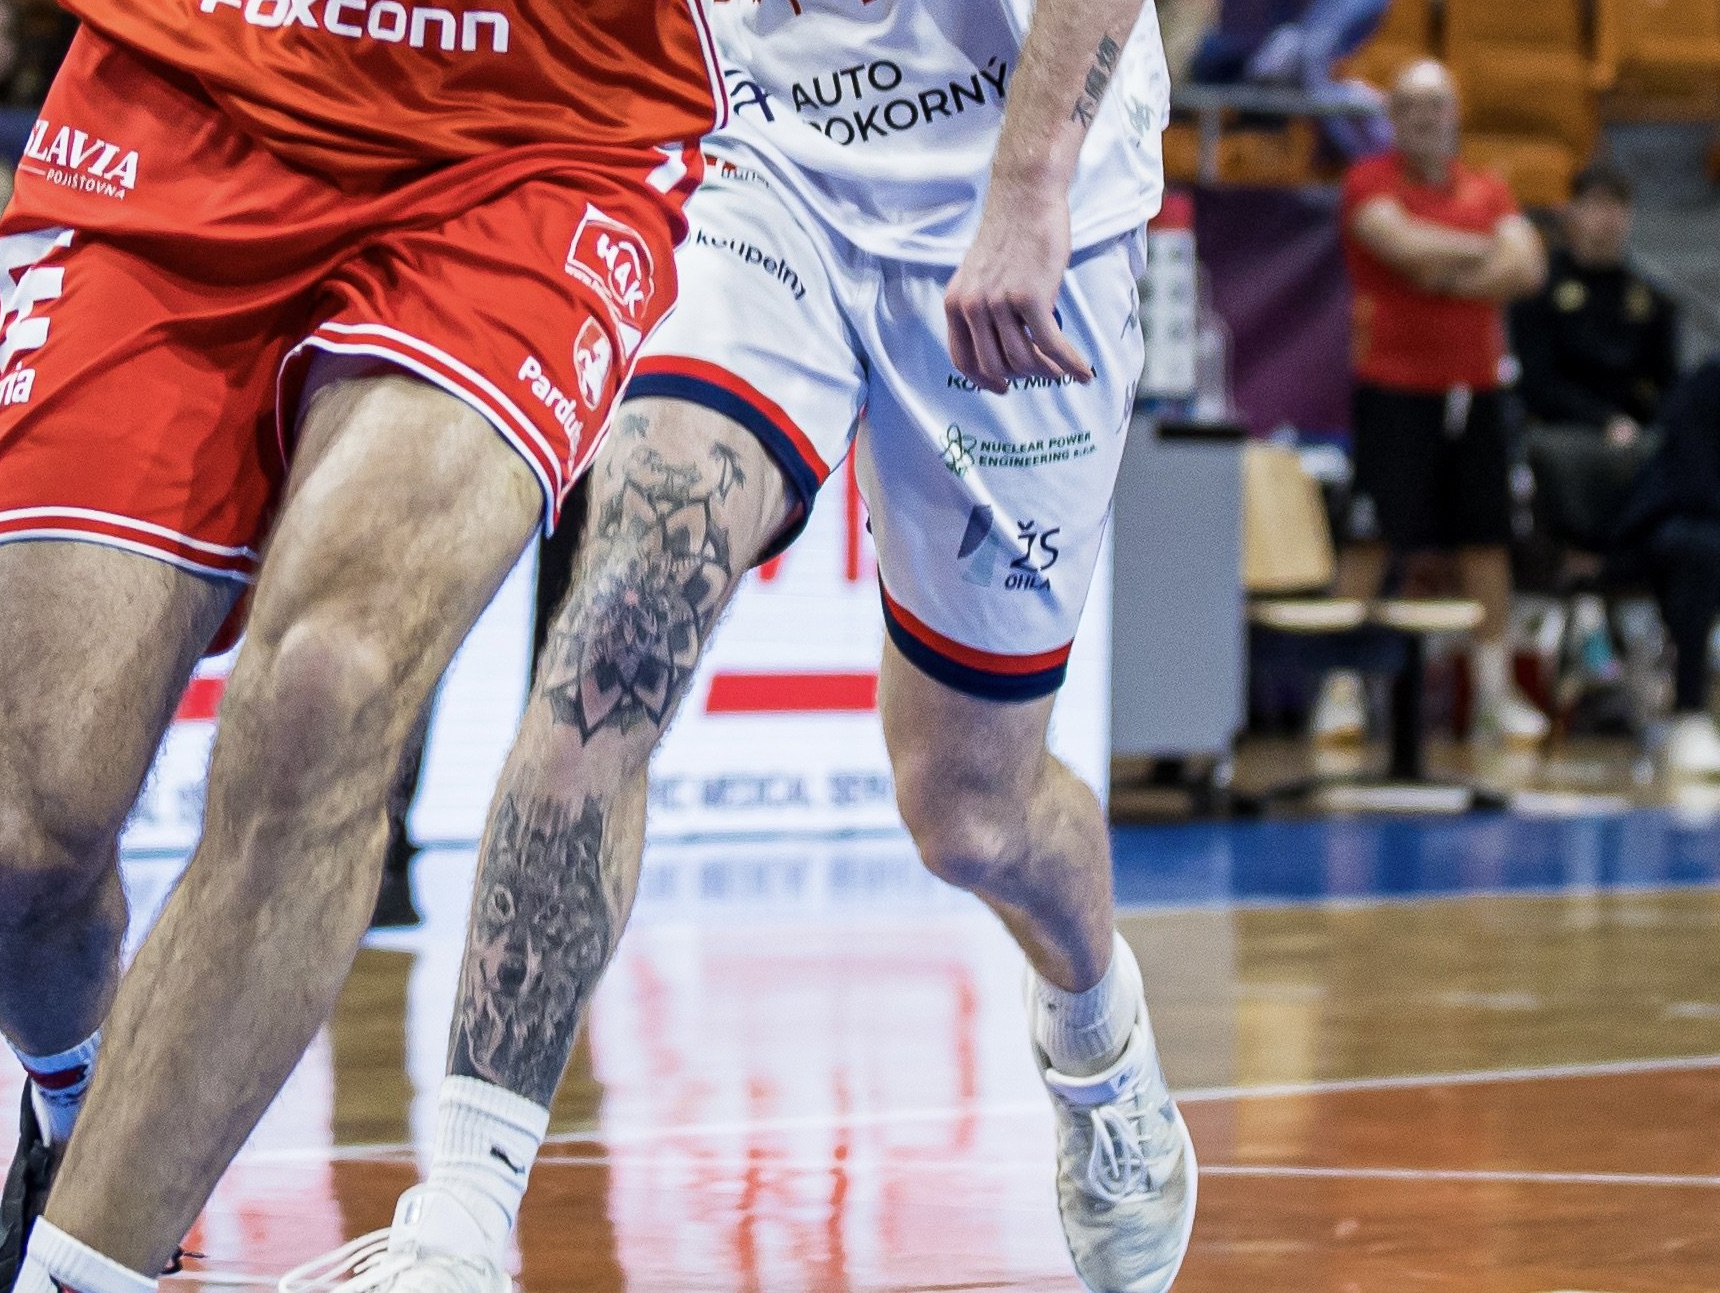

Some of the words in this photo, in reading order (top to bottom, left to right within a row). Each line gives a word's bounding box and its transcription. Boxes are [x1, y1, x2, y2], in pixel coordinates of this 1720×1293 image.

[791, 60, 902, 113] AUTO
[803, 56, 1008, 146] OKORNÝ
[980, 451, 1069, 467] ENGINEERING
[981, 440, 1044, 453] NUCLEAR
[1048, 430, 1091, 448] POWER
[1010, 520, 1061, 573] ŽS
[1004, 573, 1050, 592] OHLA
